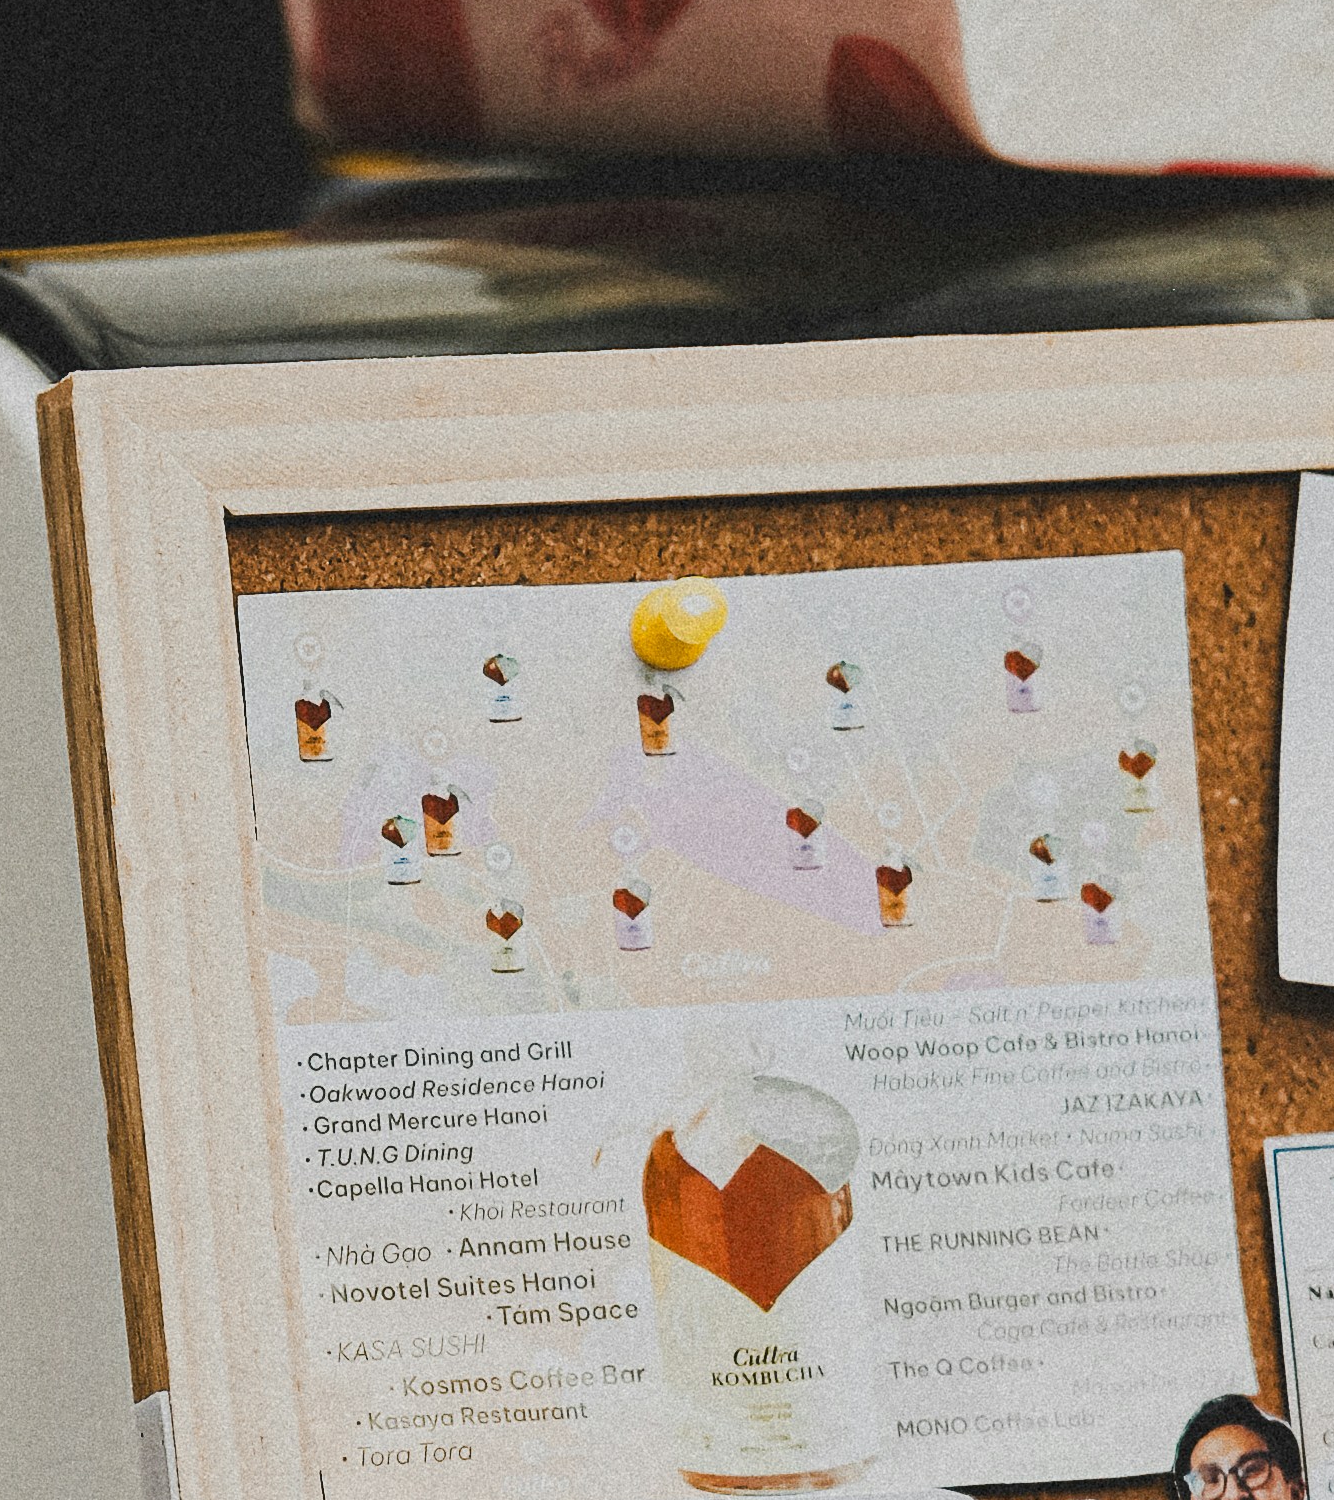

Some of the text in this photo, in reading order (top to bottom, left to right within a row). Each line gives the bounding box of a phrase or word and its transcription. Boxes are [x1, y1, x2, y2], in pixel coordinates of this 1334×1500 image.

[968, 1005, 1011, 1025] Salt
[1037, 1000, 1108, 1025] Pepper
[308, 1041, 572, 1073] Chapter Dining and Grill
[845, 1024, 1199, 1064] Woop Woop Cafe & Bistro Hanoi
[310, 1071, 606, 1103] Oakwood Residence Hanoi
[873, 1057, 1201, 1092] Habakuk Fine Coffee and Bistro
[1061, 1090, 1203, 1115] JAZ IZAKAYA
[314, 1105, 548, 1135] Grand Mercure Hanoi
[988, 1130, 1058, 1151] Market
[318, 1142, 474, 1167] T.U.N.G Dining
[995, 1162, 1048, 1184] Kids
[1056, 1158, 1114, 1181] Cafe
[317, 1168, 538, 1202] Capella Hanoi Hotel
[1145, 1188, 1214, 1209] Coffee
[511, 1197, 625, 1219] Restaurant
[459, 1237, 546, 1258] Annam
[554, 1231, 631, 1252] House
[882, 1224, 1099, 1252] THE RUNNING BEAN
[1054, 1255, 1091, 1274] The
[1097, 1251, 1158, 1272] Bottle
[331, 1269, 596, 1304] Novotel Suites Hanoi
[968, 1284, 1157, 1313] Burger and Bistro
[558, 1301, 639, 1327] Space
[337, 1334, 486, 1363] KASA SUSHI
[403, 1364, 646, 1397] Kosmos Coffee Bar
[711, 1365, 825, 1387] KOMBUCHA
[888, 1354, 1032, 1380] The Q Coffee
[368, 1402, 588, 1432] Kasaya Restaurant
[896, 1409, 1095, 1438] MONO Coffee Lab
[358, 1442, 473, 1467] Tora Tora
